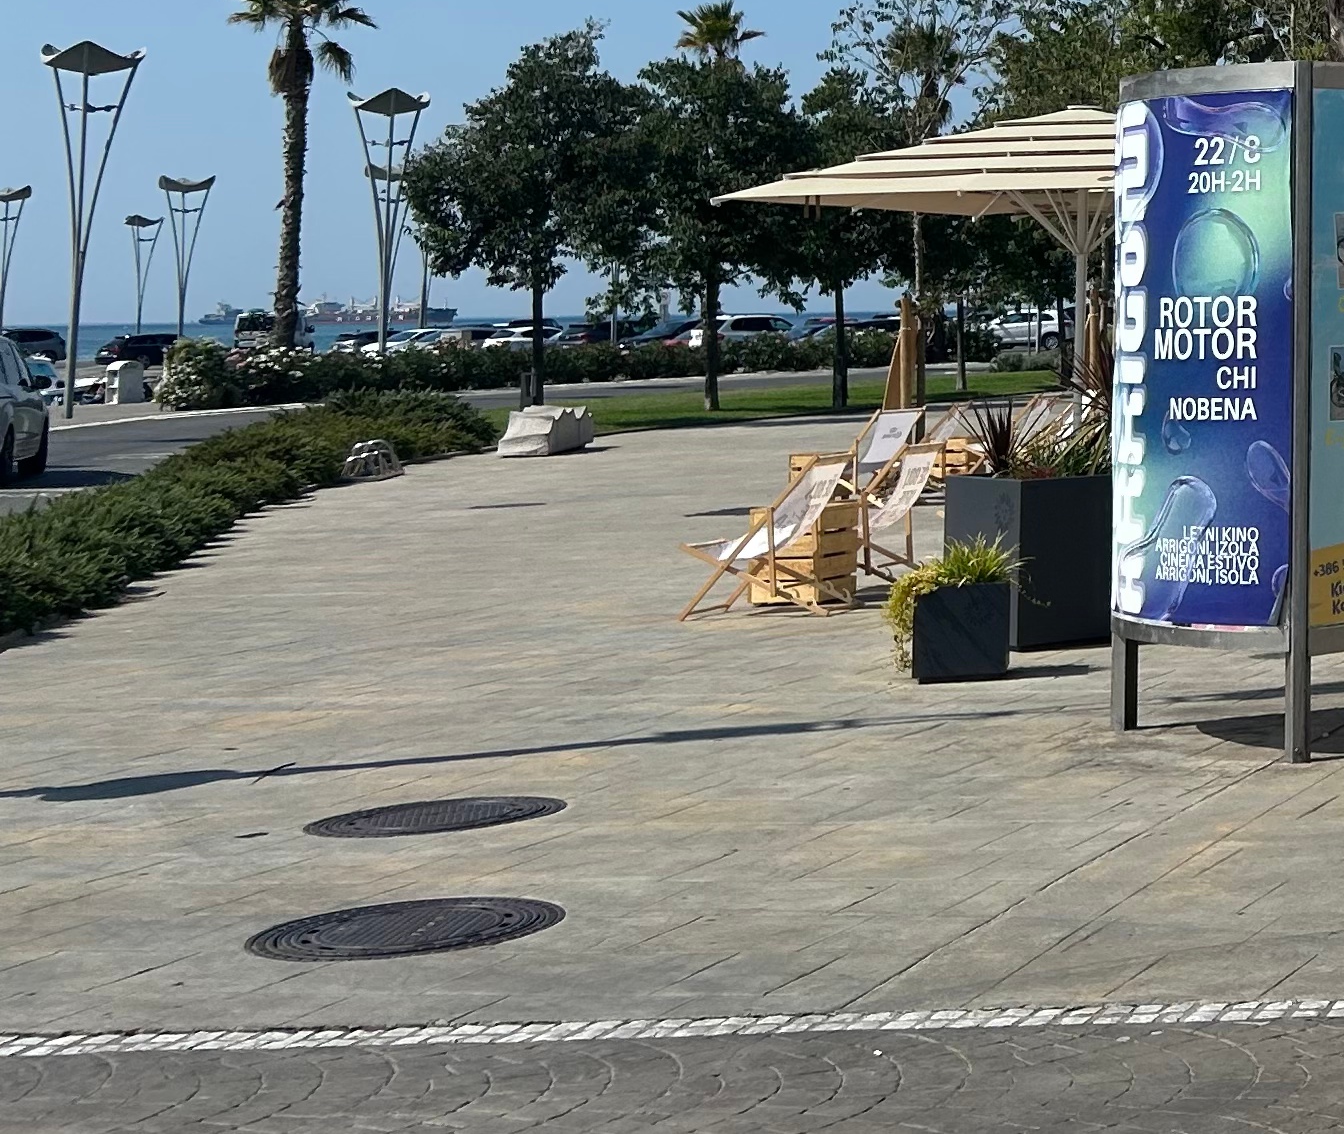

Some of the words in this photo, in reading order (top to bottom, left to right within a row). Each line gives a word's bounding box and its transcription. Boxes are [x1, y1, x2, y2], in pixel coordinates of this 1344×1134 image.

[1188, 169, 1260, 194] 20H-2H
[1160, 295, 1257, 328] ROTOR
[1154, 328, 1257, 360] MOTOR
[1216, 366, 1257, 390] CHI
[1169, 397, 1257, 421] NOBENA
[1183, 525, 1219, 542] LETNI
[1222, 527, 1259, 543] KINO
[1215, 541, 1259, 557] IZOLA
[1160, 552, 1204, 569] CINEMA
[1207, 555, 1259, 571] ESTIVO
[1313, 560, 1339, 577] +386
[1155, 565, 1213, 586] ARRIGONI,
[1215, 569, 1259, 585] ISOLA
